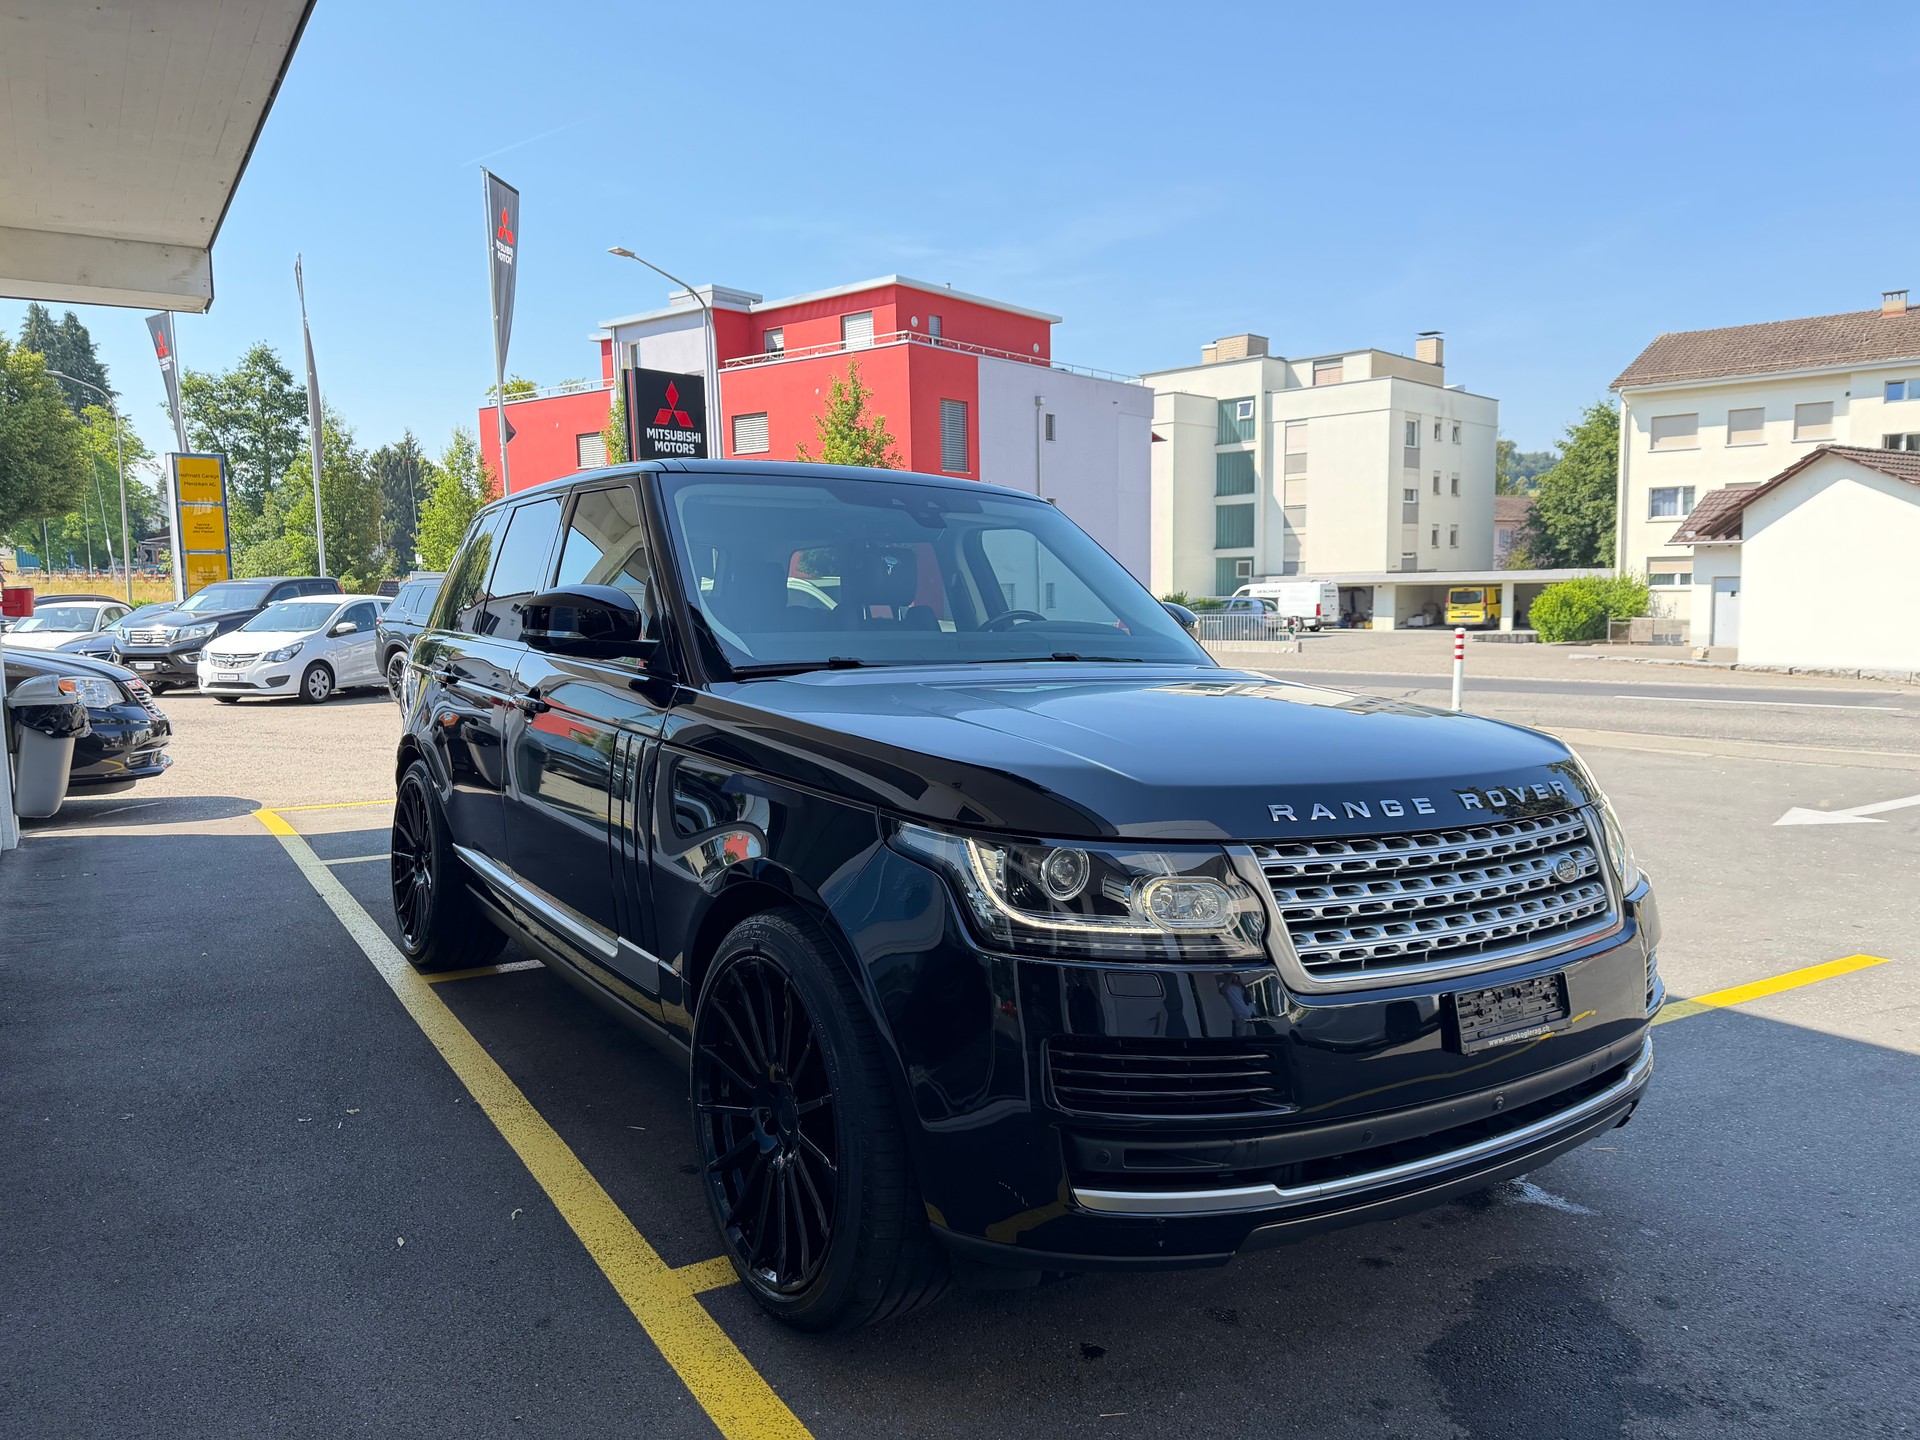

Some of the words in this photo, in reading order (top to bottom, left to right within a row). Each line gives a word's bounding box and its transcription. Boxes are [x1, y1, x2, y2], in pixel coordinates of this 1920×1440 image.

[646, 427, 702, 443] MITSUBISHI
[654, 441, 696, 454] MOTORS
[1267, 797, 1436, 822] RANGE
[1458, 780, 1568, 810] ROVER
[1488, 1025, 1550, 1046] www.autokoglerag.ch
